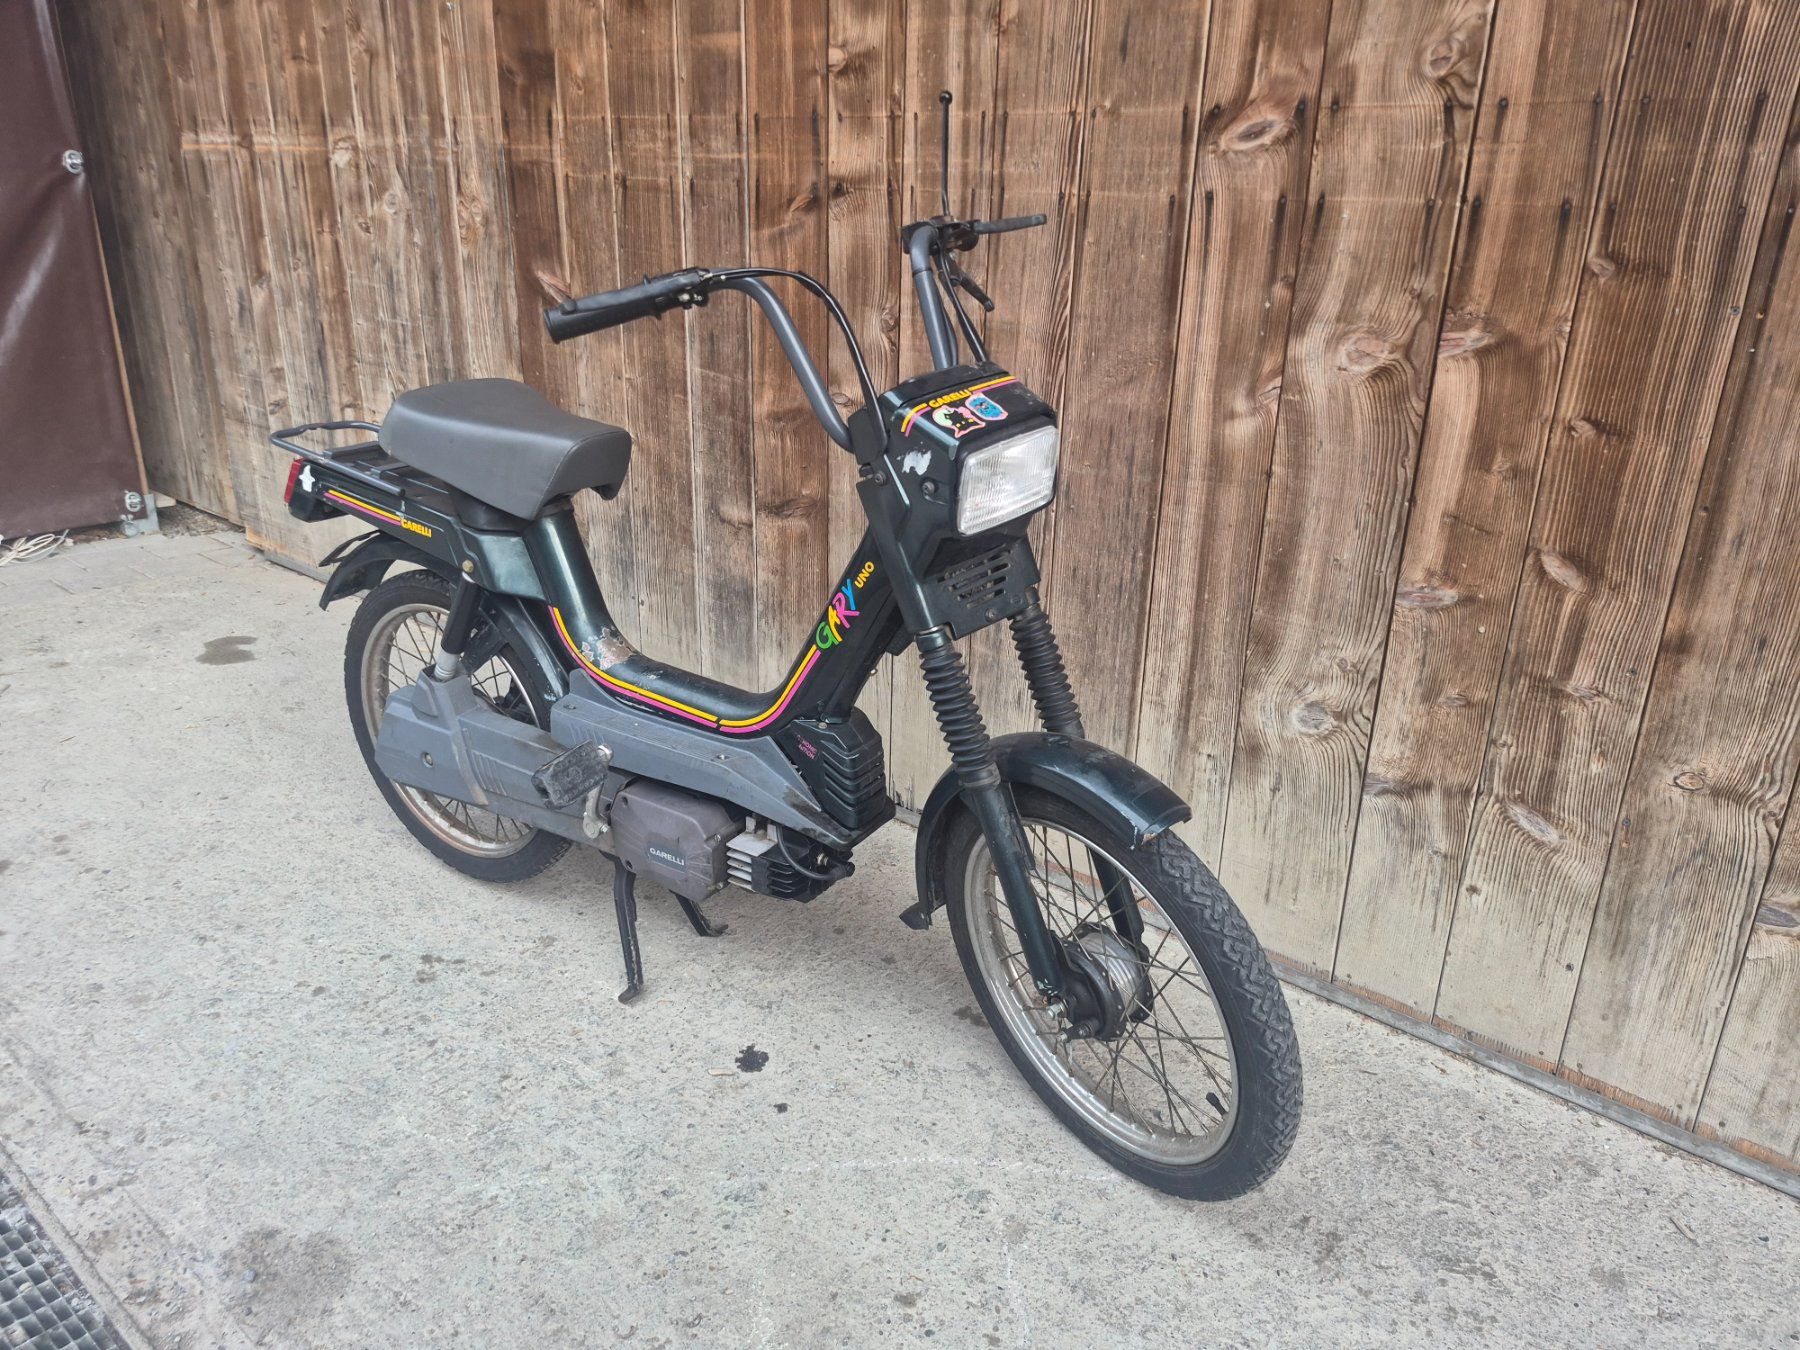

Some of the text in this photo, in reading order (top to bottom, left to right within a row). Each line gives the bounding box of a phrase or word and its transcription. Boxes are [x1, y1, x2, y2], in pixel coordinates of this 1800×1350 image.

[928, 389, 971, 408] GARELLI
[401, 519, 433, 538] GARELLI
[815, 561, 875, 649] GARY UNO
[649, 847, 685, 866] GARELLI
